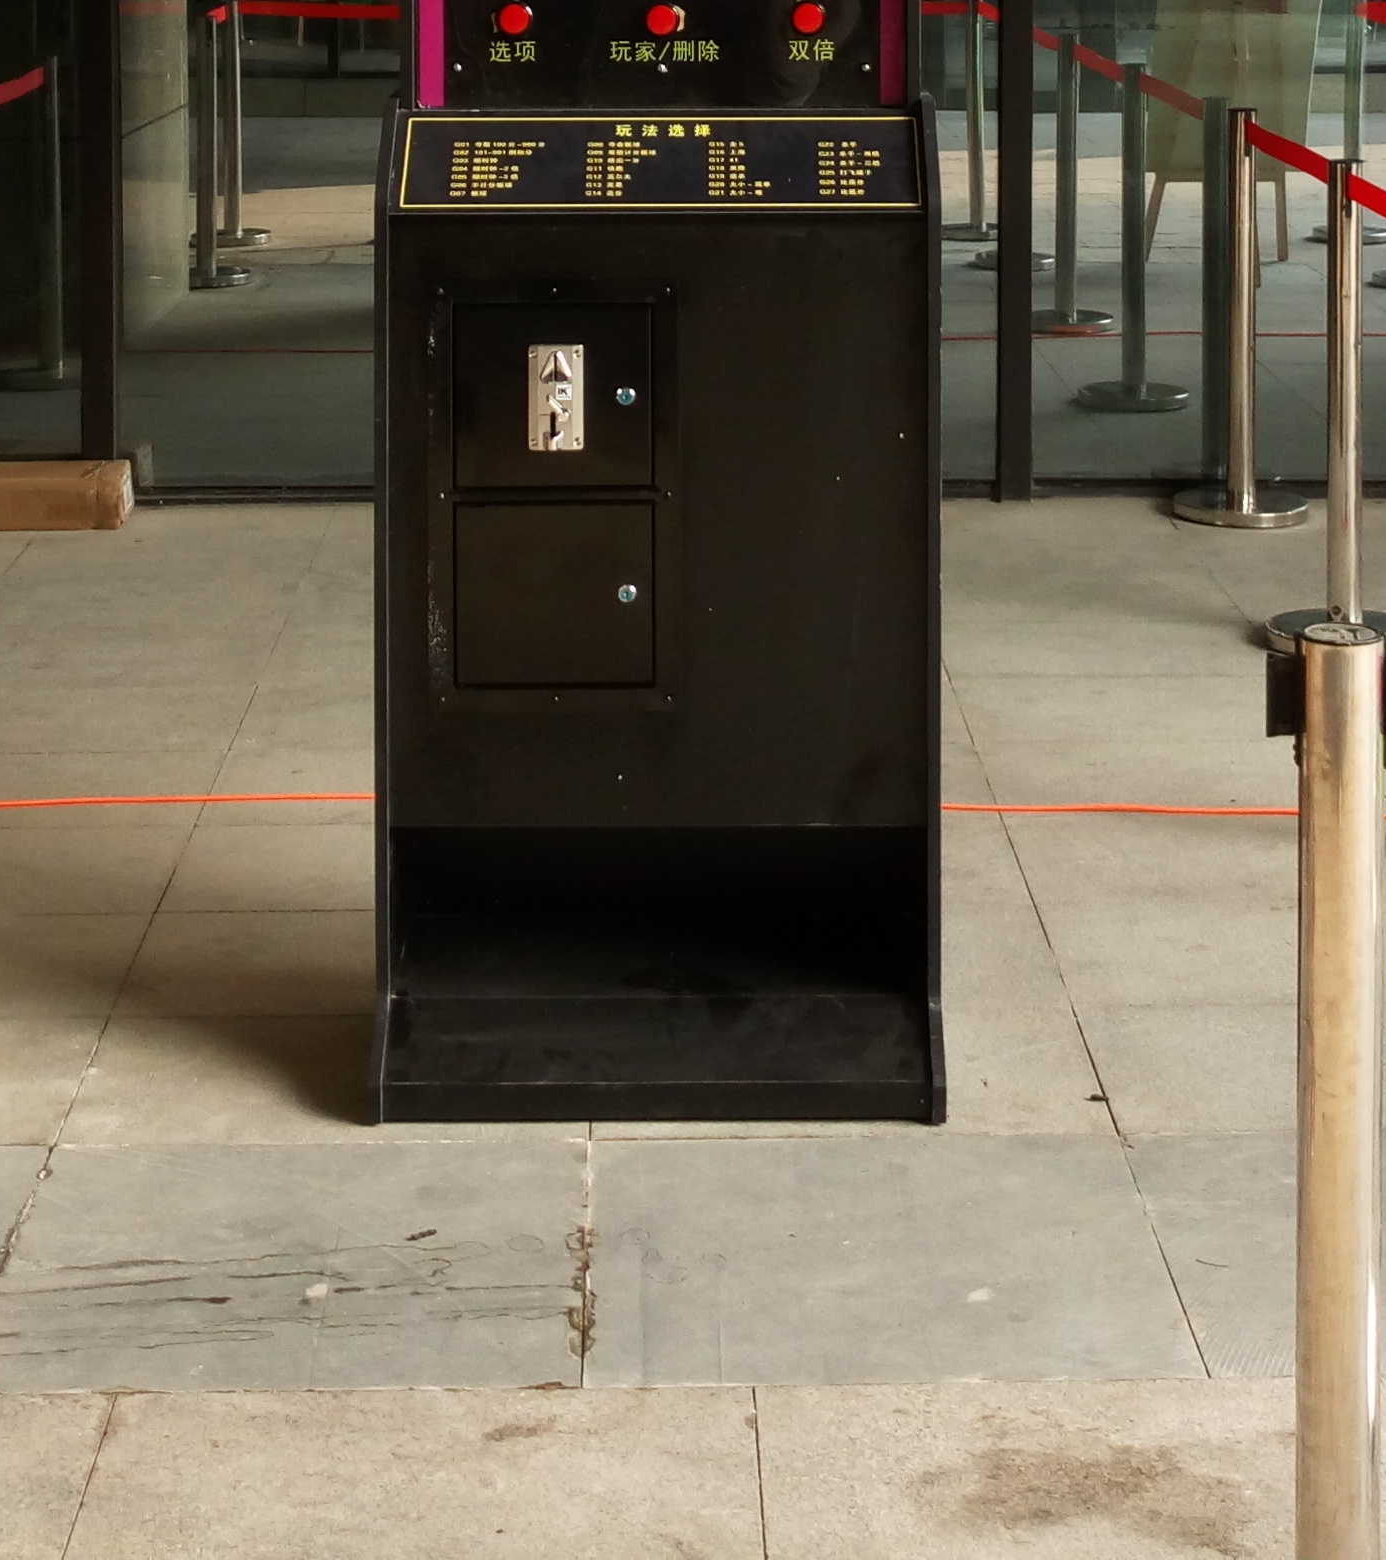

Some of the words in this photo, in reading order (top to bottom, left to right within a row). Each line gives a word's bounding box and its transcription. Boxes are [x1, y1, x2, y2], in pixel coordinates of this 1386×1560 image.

[490, 41, 535, 61] 选项
[610, 40, 719, 61] 玩家/删除
[789, 39, 834, 60] 双倍
